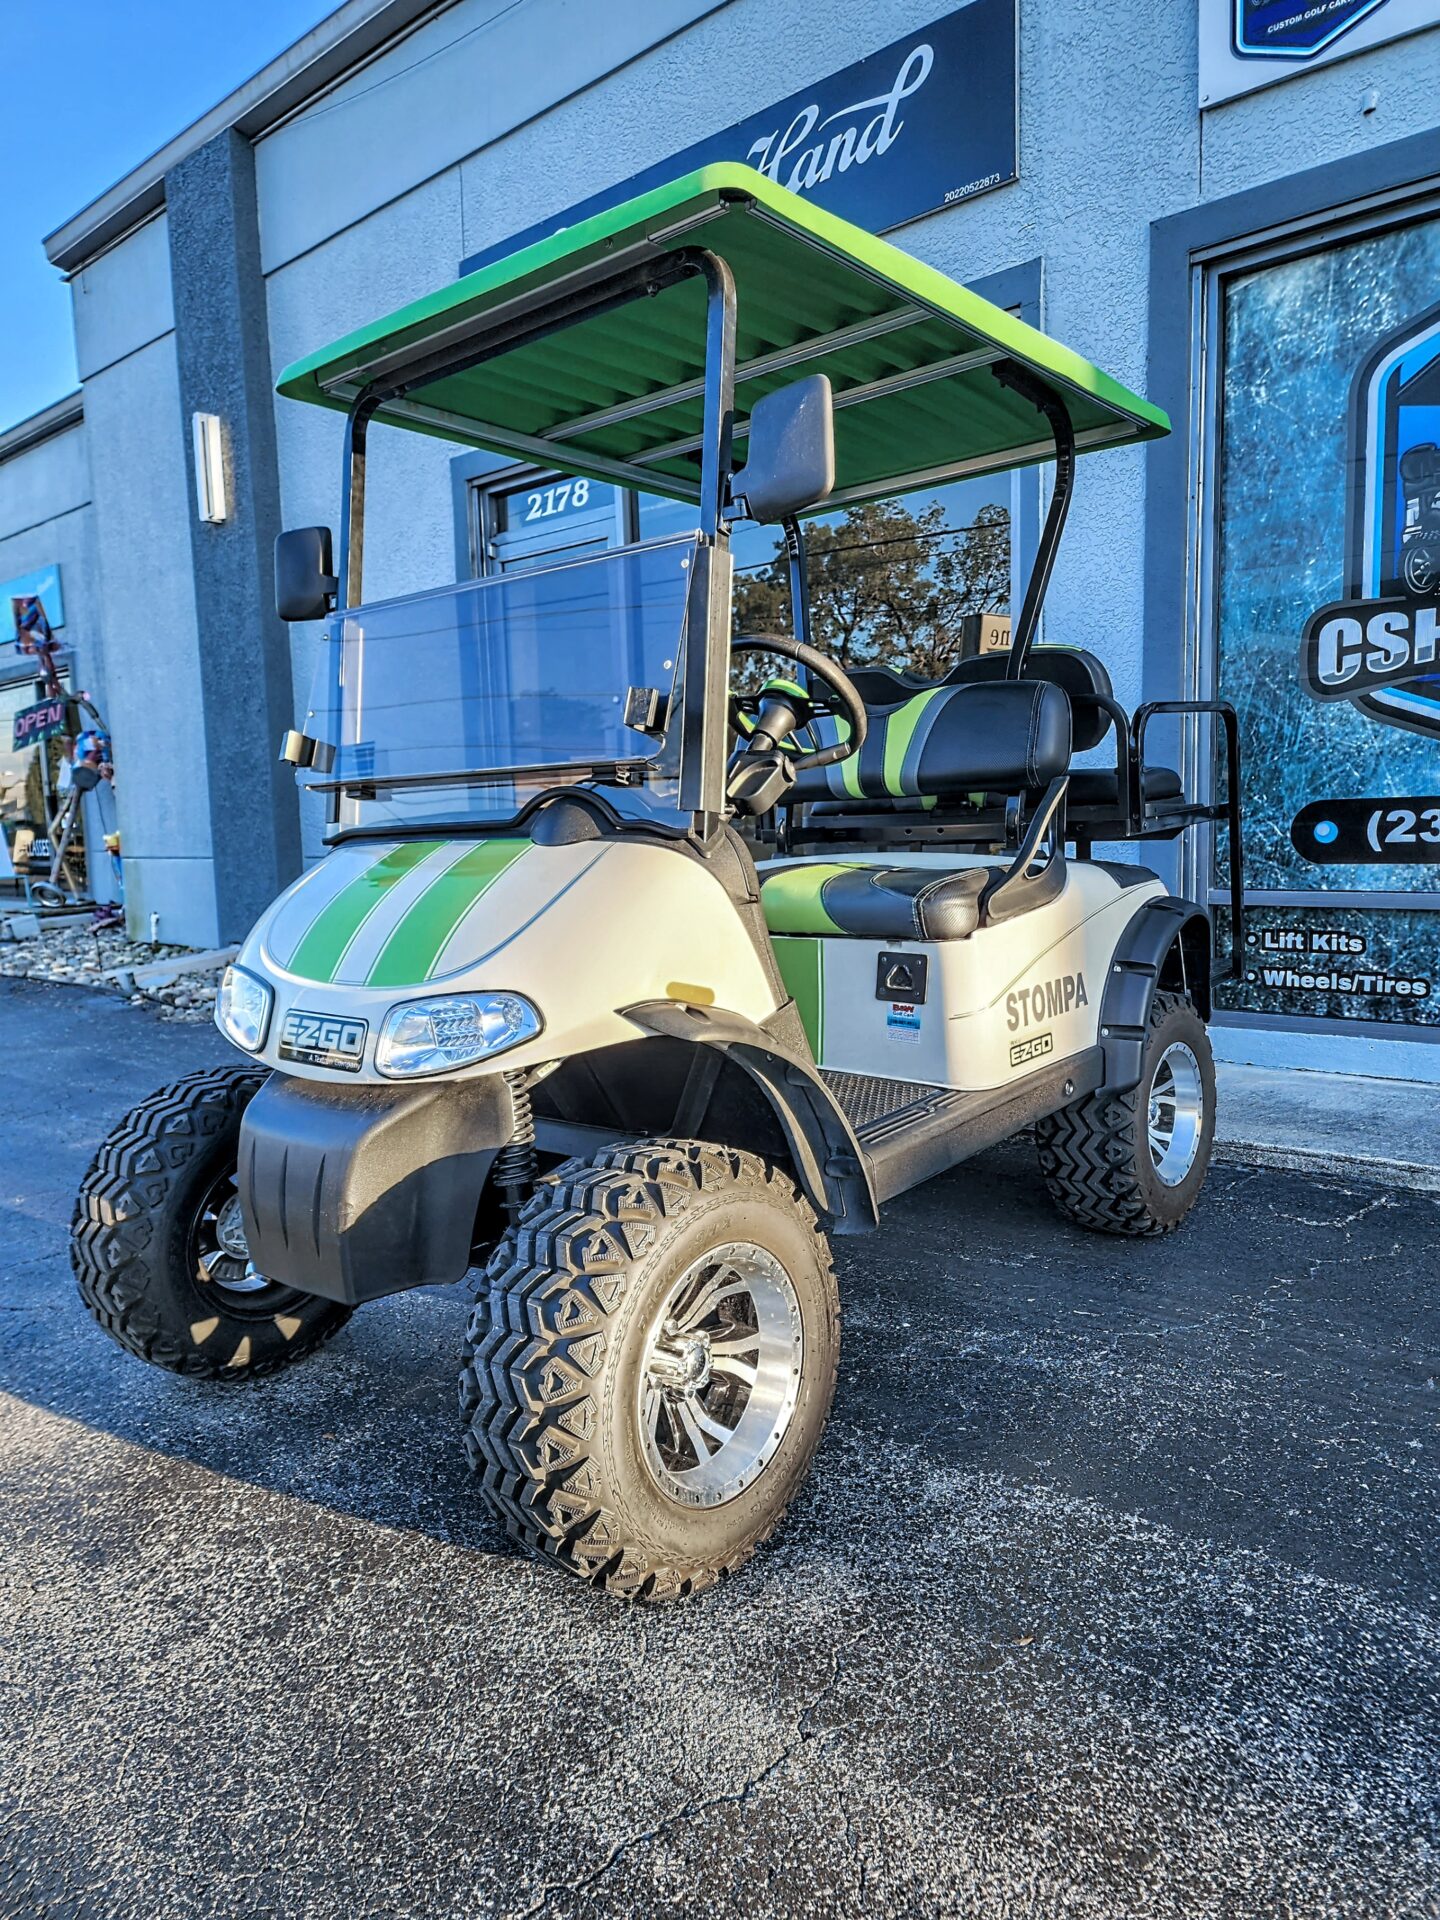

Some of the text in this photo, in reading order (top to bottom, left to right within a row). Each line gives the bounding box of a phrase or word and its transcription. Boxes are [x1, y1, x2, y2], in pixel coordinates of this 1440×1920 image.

[1267, 0, 1350, 33] CUSTOM GOLF CAR
[746, 44, 935, 194] Hand
[944, 172, 1001, 203] 20220522873
[525, 479, 590, 521] 2178
[15, 703, 62, 738] OPEN
[1264, 932, 1363, 952] Lift Kits
[1263, 969, 1428, 996] Wheels/Tires
[1006, 972, 1089, 1032] STOMPA
[282, 1016, 364, 1053] EZGO
[1010, 1034, 1053, 1066] EZGO
[334, 1058, 361, 1071] Company
